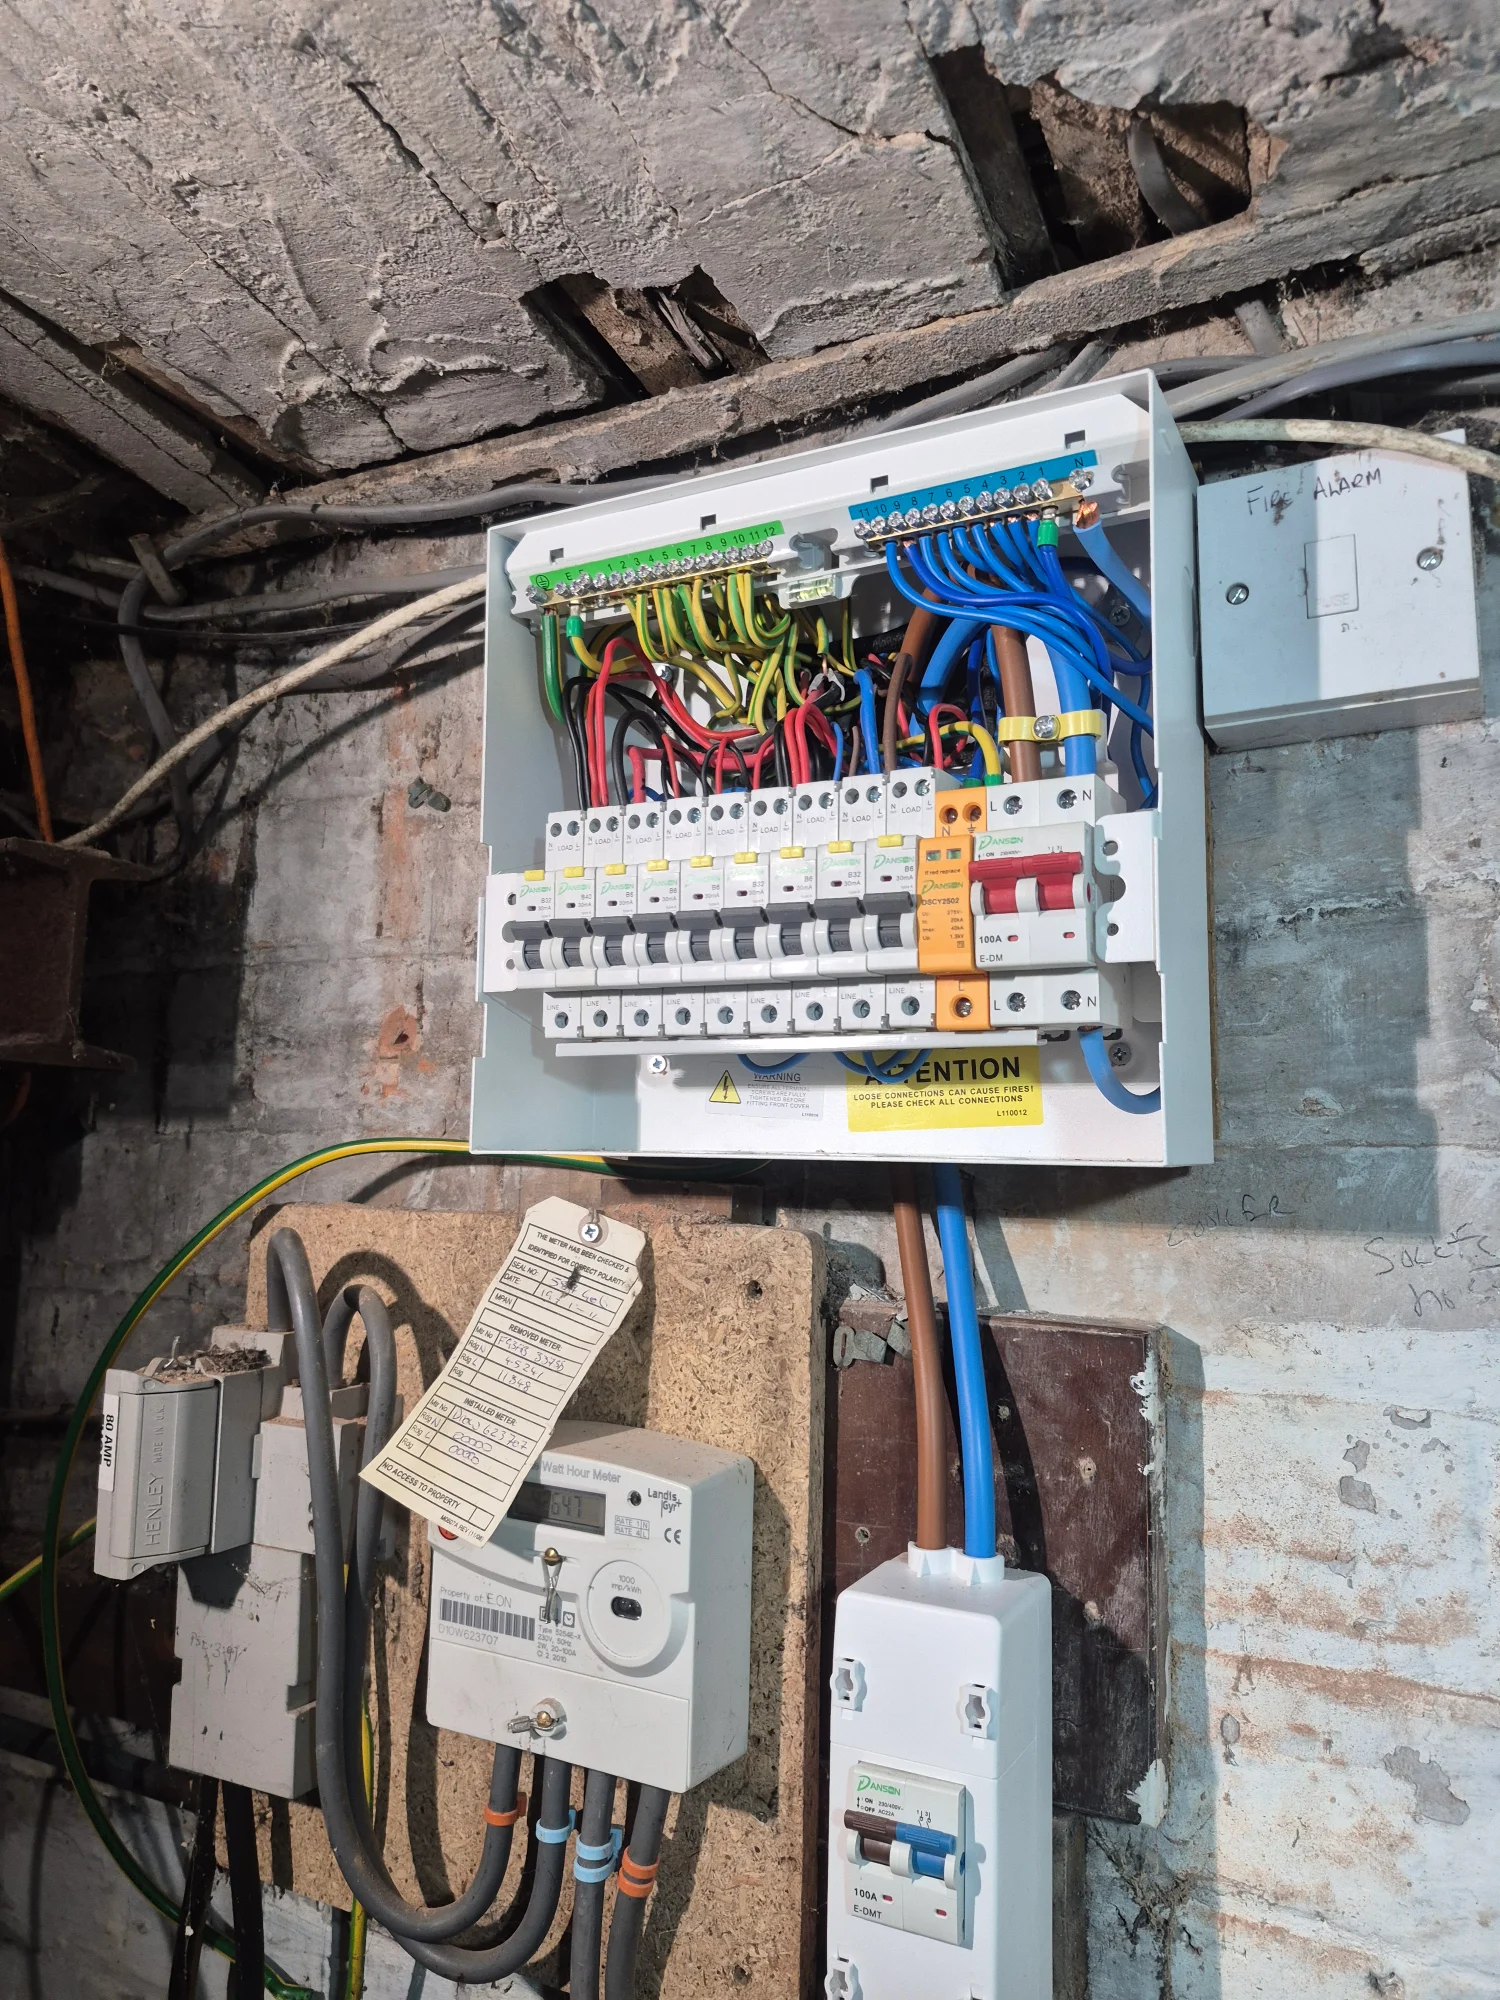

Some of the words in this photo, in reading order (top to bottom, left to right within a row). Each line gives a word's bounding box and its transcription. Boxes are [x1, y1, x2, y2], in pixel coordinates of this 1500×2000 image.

[874, 503, 887, 514] 10
[893, 500, 900, 510] 9
[911, 496, 918, 506] 8
[928, 492, 934, 502] 7
[945, 488, 953, 498] 6
[963, 483, 971, 494] 5
[981, 479, 989, 489] 4
[1000, 475, 1007, 485] 3
[1018, 471, 1026, 481] 2
[1038, 466, 1045, 476] 1
[1074, 457, 1084, 467] N
[1313, 467, 1381, 500] ALARM
[564, 571, 573, 581] E
[607, 563, 613, 572] 1
[620, 560, 627, 569] 2
[633, 557, 641, 566] 3
[648, 554, 655, 563] 4
[662, 551, 669, 560] 5
[676, 548, 683, 557] 6
[690, 545, 697, 553] 7
[705, 541, 713, 550] 8
[720, 538, 728, 547] 9
[733, 534, 745, 544] 10
[749, 530, 760, 540] 11
[763, 527, 777, 537] 12
[990, 800, 997, 812] L
[1082, 789, 1092, 801] N
[852, 814, 871, 822] LOAD
[941, 826, 951, 837] N
[978, 835, 1024, 851] DANSON
[873, 854, 914, 869] DANSON
[600, 881, 634, 895] DANSON
[643, 878, 678, 891] DANSON
[921, 879, 964, 895] DANSON
[979, 935, 1002, 944] 100A
[979, 954, 1004, 963] E-DM
[958, 981, 965, 991] L
[993, 1000, 1001, 1011] L
[1087, 996, 1097, 1007] N
[853, 1092, 882, 1101] LOOSE
[884, 1089, 945, 1099] CONNECTIONS
[948, 1088, 968, 1096] CAN
[970, 1086, 1000, 1095] CAUSE
[1003, 1085, 1034, 1093] FIRES!
[870, 1101, 903, 1109] PLEASE
[905, 1099, 936, 1107] CHECK
[938, 1098, 956, 1106] ALL
[958, 1094, 1023, 1105] CONNECTIONS
[996, 1109, 1027, 1117] L110012
[537, 1231, 548, 1241] THE
[549, 1236, 569, 1249] METER
[568, 1244, 581, 1254] HAS
[580, 1249, 598, 1261] BEEN
[597, 1254, 624, 1271] CHECKED
[511, 1260, 526, 1272] SEAL
[527, 1243, 558, 1260] IDENTIFIED
[558, 1255, 571, 1265] FOR
[597, 1271, 626, 1287] POLARITY
[503, 1272, 520, 1284] DATE
[494, 1293, 513, 1305] MPAN
[484, 1330, 494, 1339] No
[508, 1323, 540, 1342] REMOVED
[461, 1353, 472, 1363] Rdg
[452, 1366, 464, 1377] Rdg
[155, 1404, 166, 1421] U.K.
[438, 1403, 448, 1412] No
[463, 1397, 496, 1417] INSTALLED
[105, 1414, 115, 1431] 80
[421, 1411, 432, 1423] Rdg
[155, 1425, 164, 1438] IN
[411, 1425, 423, 1436] Rdg
[103, 1434, 113, 1467] AMP
[401, 1438, 414, 1449] Rdg
[153, 1439, 164, 1464] MADE
[541, 1461, 564, 1474] Watt
[566, 1464, 591, 1478] Hour
[592, 1469, 621, 1484] Meter
[382, 1461, 393, 1472] NO
[392, 1467, 418, 1487] ACCESS
[418, 1481, 428, 1491] TO
[426, 1485, 461, 1510] PROPERTY
[647, 1487, 677, 1502] Landis
[145, 1472, 163, 1547] HENLEY
[616, 1517, 633, 1526] RATE
[615, 1526, 632, 1535] RATE
[618, 1574, 636, 1585] 1000
[440, 1586, 471, 1601] Property
[438, 1624, 499, 1645] D10W623707
[556, 1637, 572, 1647] 50Hz
[551, 1645, 577, 1657] 20-100A
[552, 1653, 567, 1663] 2010
[857, 1775, 901, 1796] DANSON
[878, 1809, 895, 1817] AC22A
[853, 1888, 878, 1902] 100A
[853, 1904, 882, 1919] E-DMT
